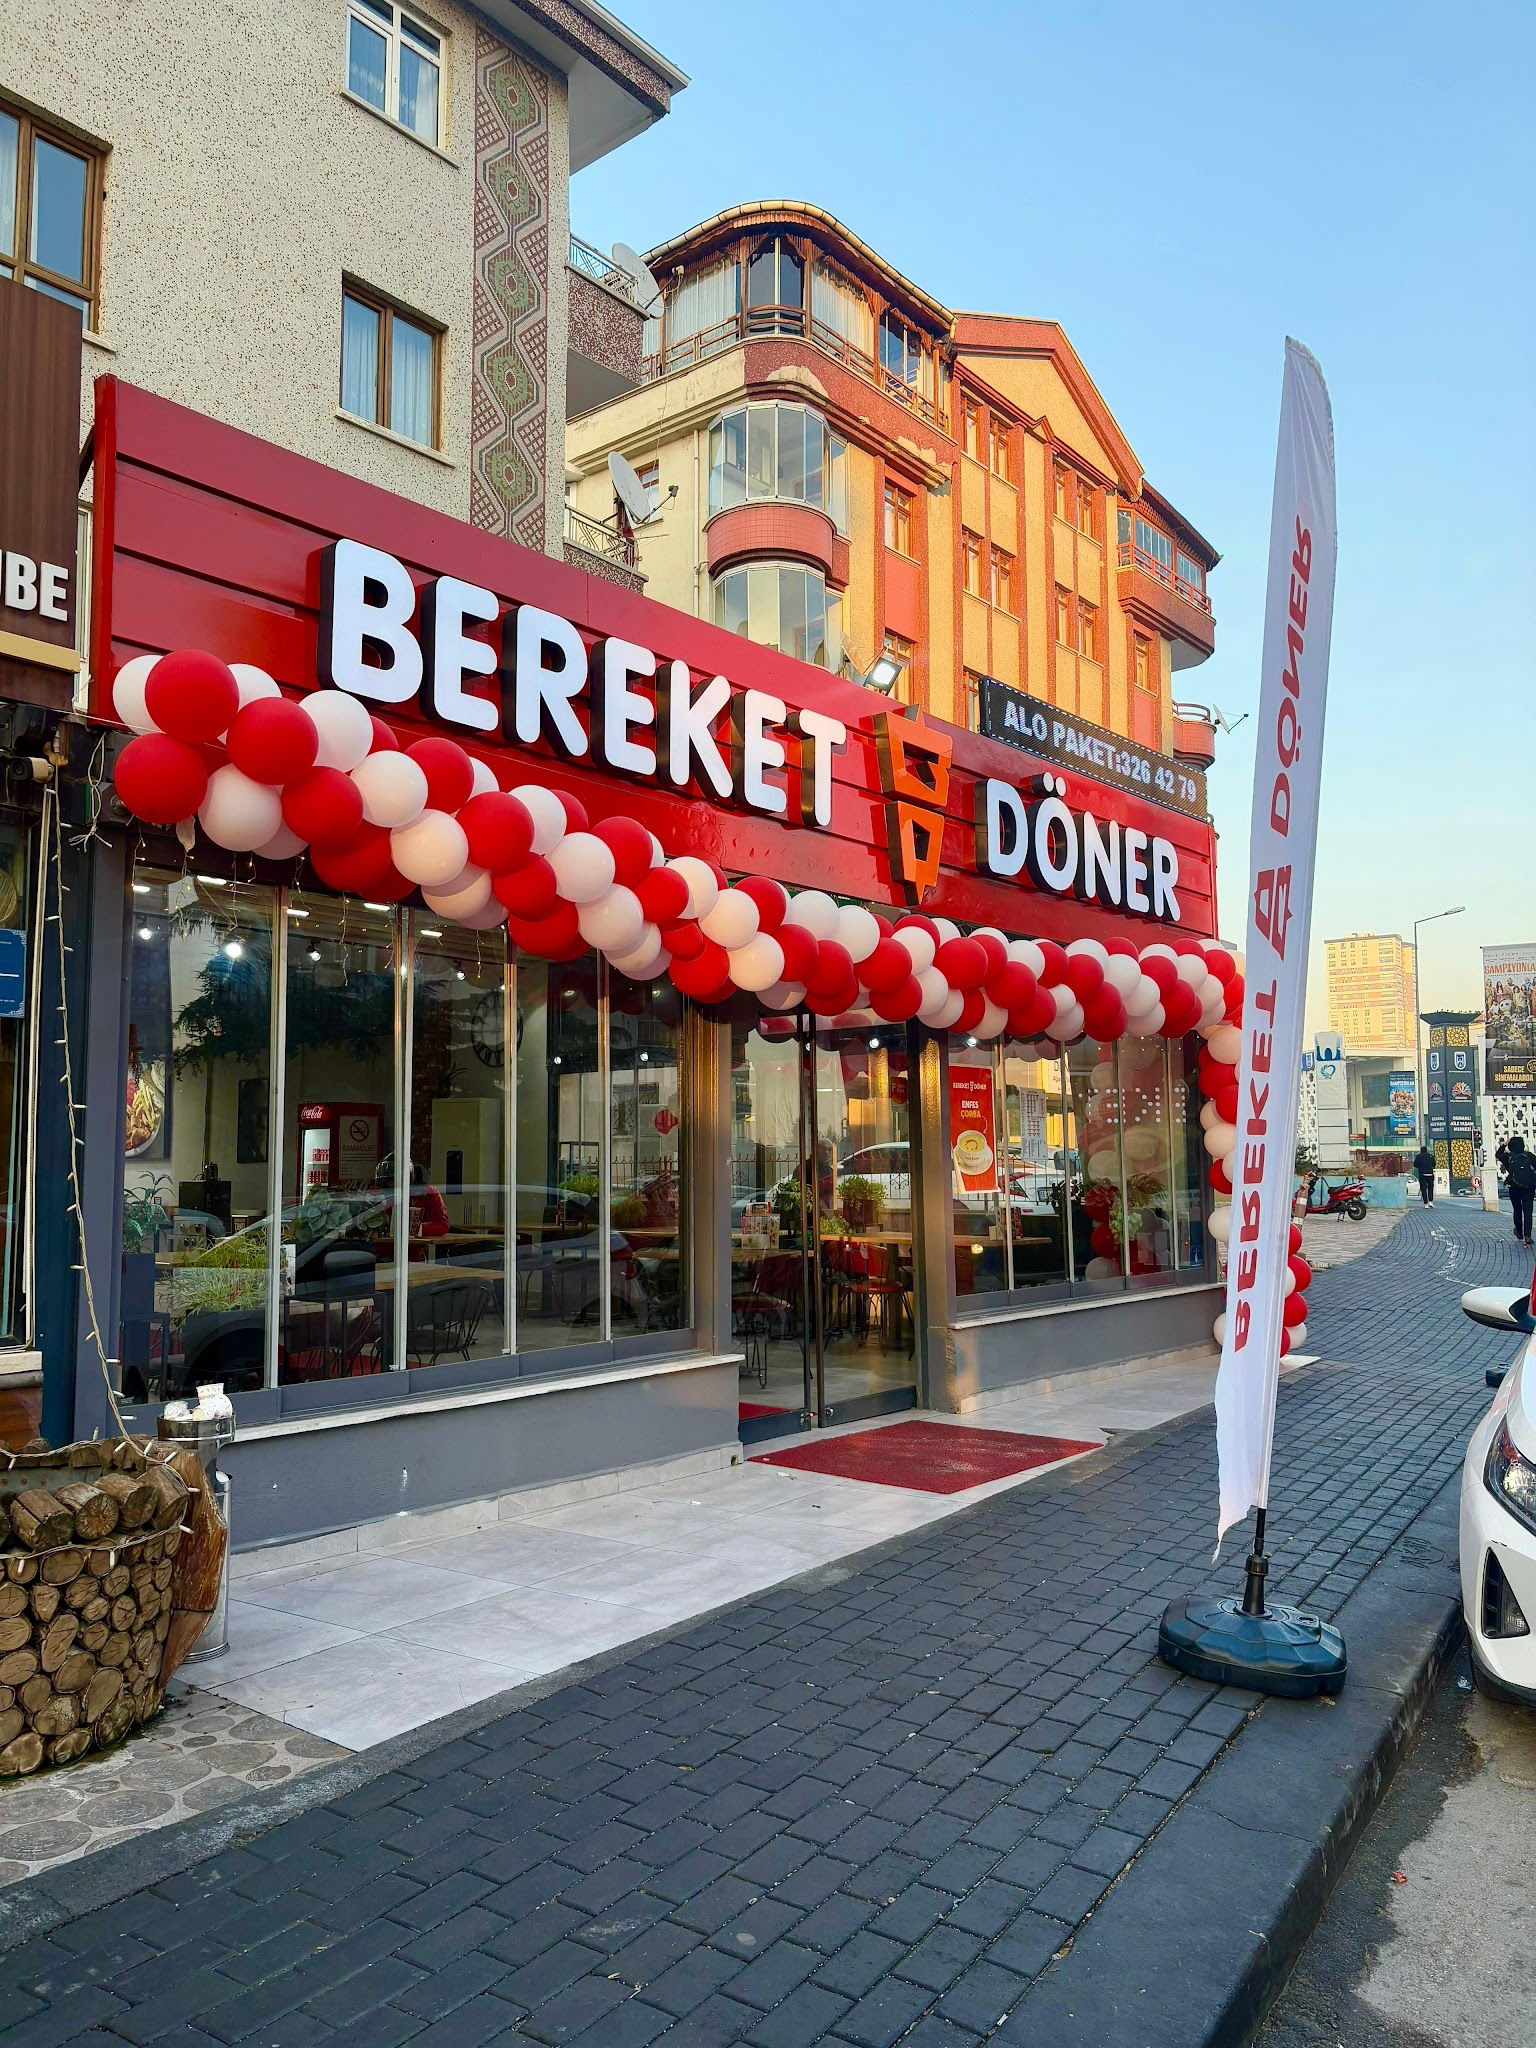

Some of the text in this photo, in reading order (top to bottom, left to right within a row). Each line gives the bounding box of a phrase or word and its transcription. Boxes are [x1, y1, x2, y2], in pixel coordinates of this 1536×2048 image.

[0, 549, 69, 622] BE
[329, 537, 1181, 922] BEREKET DÖNER
[1003, 701, 1048, 742] ALO
[1154, 767, 1175, 795] 42
[1178, 773, 1197, 803] 79
[961, 1100, 979, 1109] ENFES
[1503, 1065, 1525, 1073] SADECE
